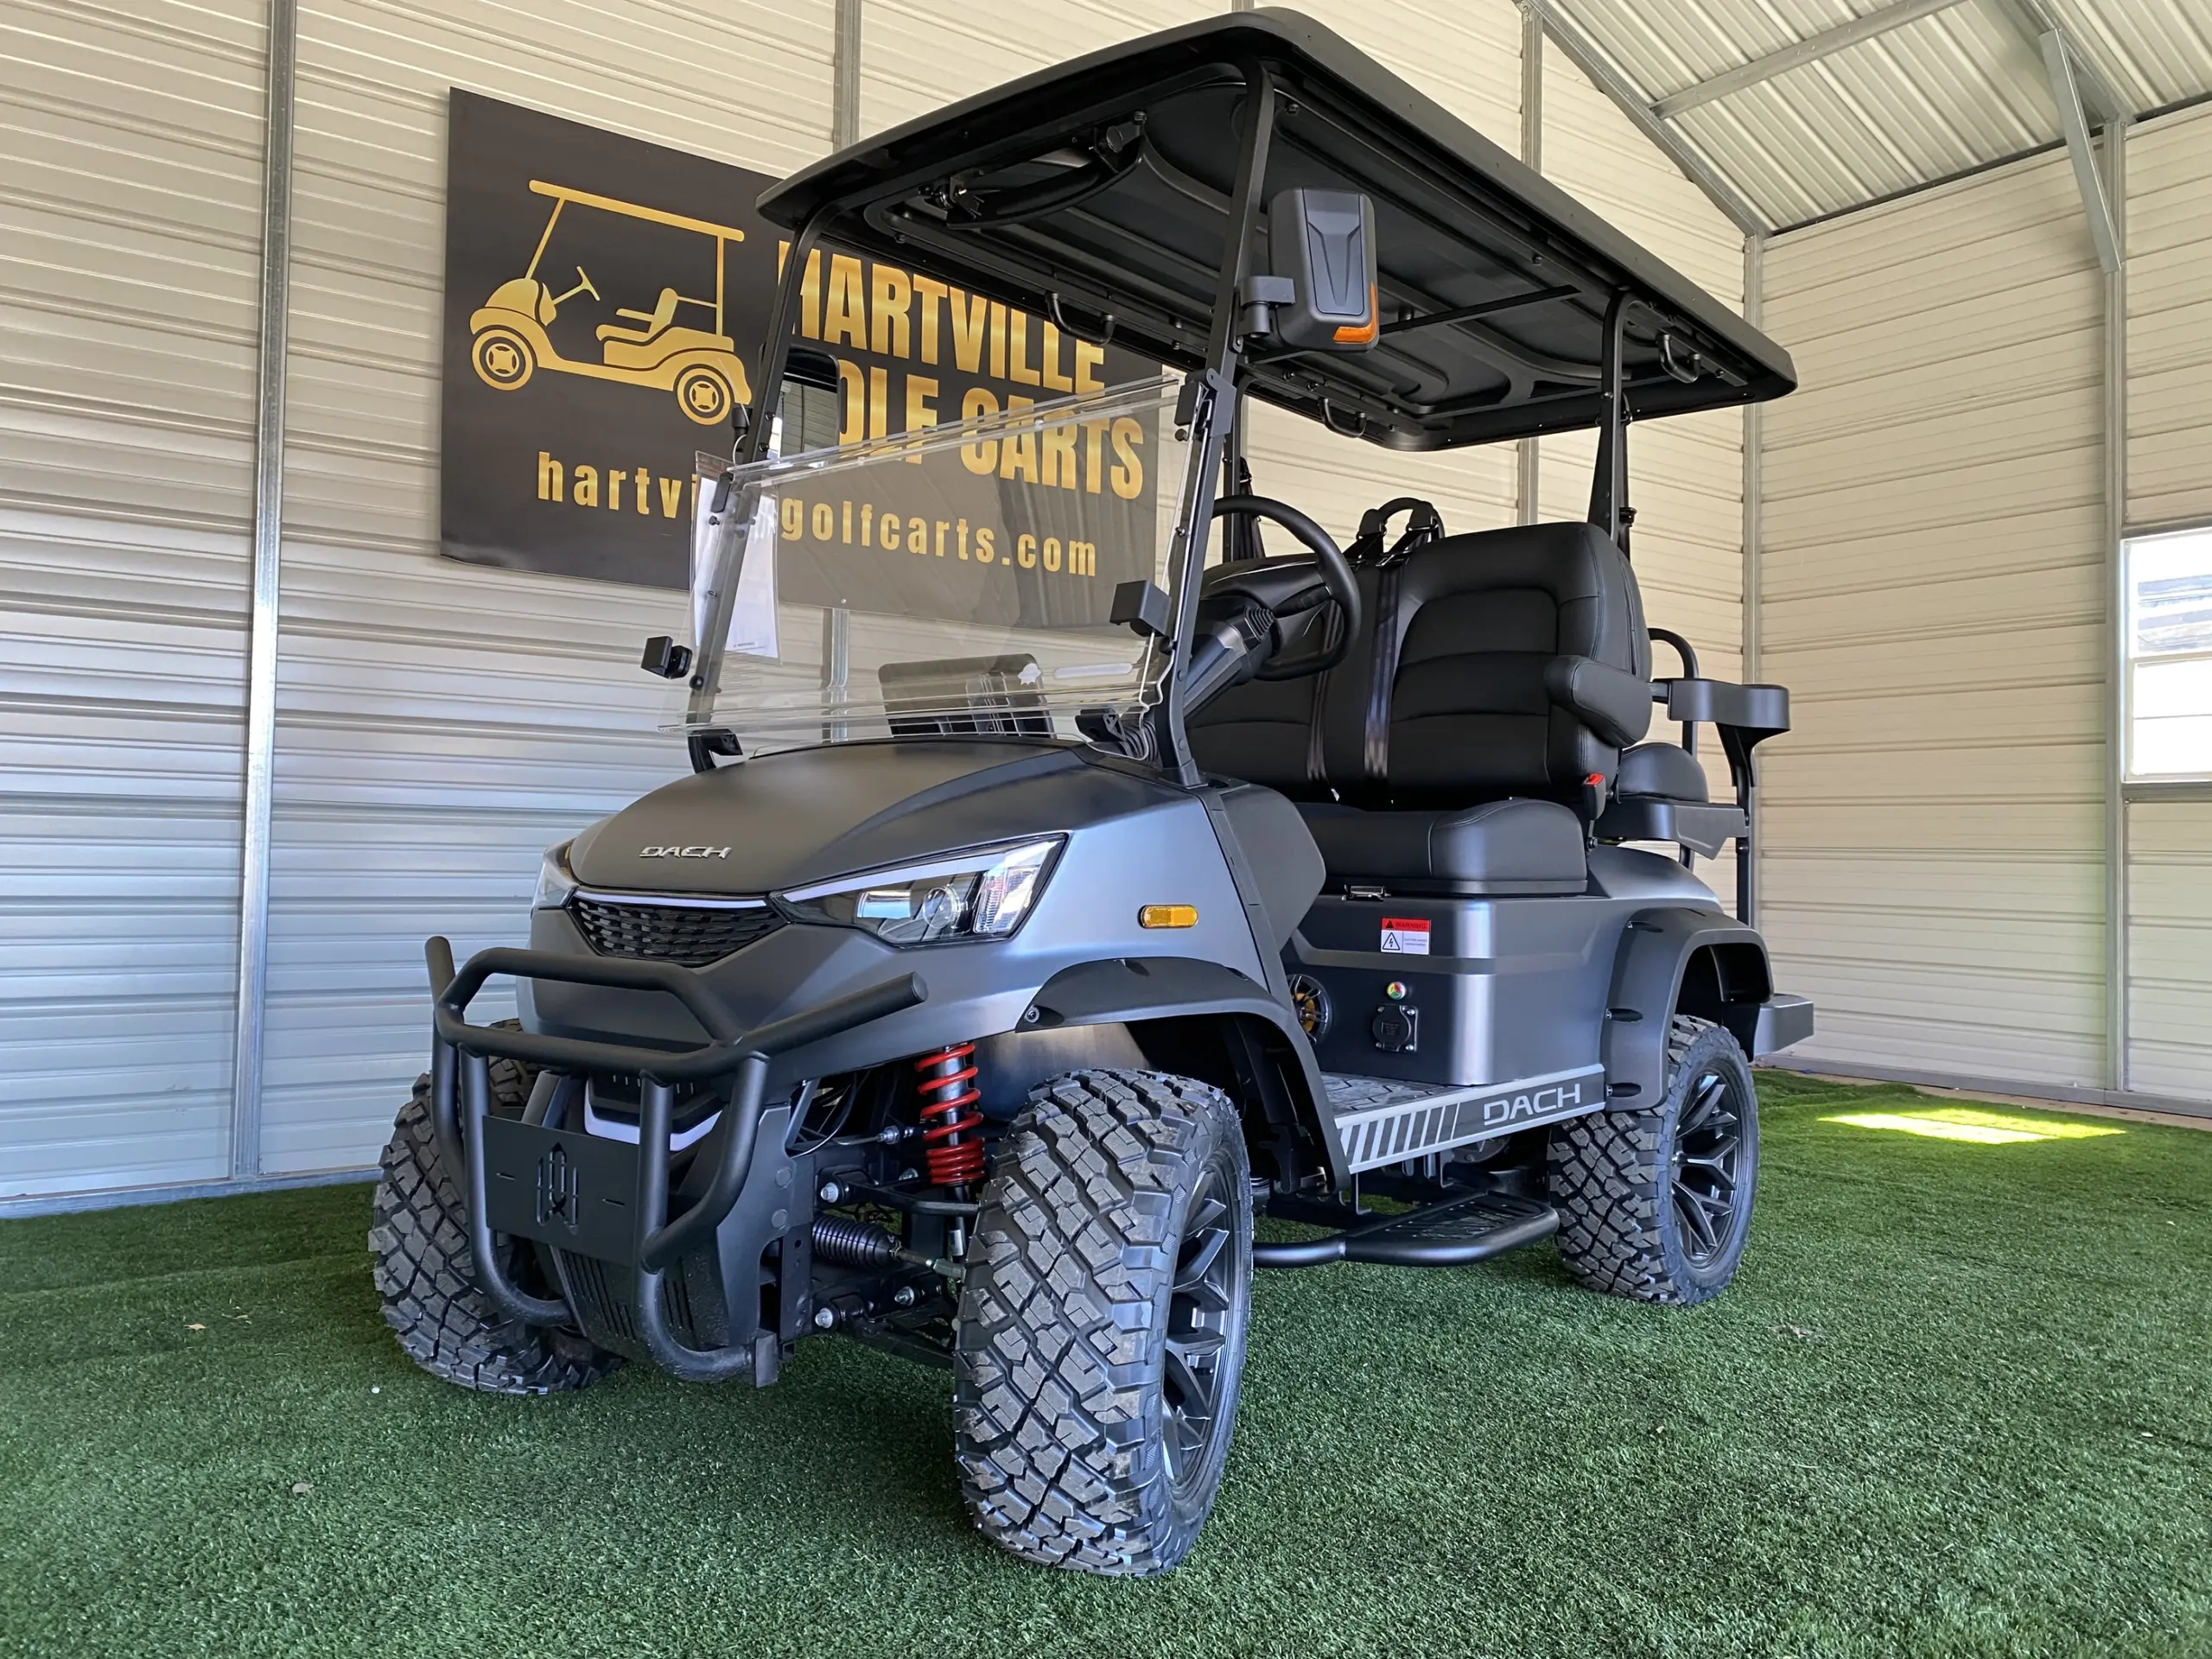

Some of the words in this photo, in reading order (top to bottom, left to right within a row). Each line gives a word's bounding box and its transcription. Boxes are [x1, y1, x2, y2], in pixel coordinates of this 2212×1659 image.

[779, 240, 1106, 398] HARTVILLE
[838, 359, 939, 465] OLF
[960, 387, 1144, 499] CARTS
[537, 451, 1096, 577] hartvgolfcarts.com
[639, 846, 732, 859] DACH
[1484, 1083, 1580, 1126] DACH
